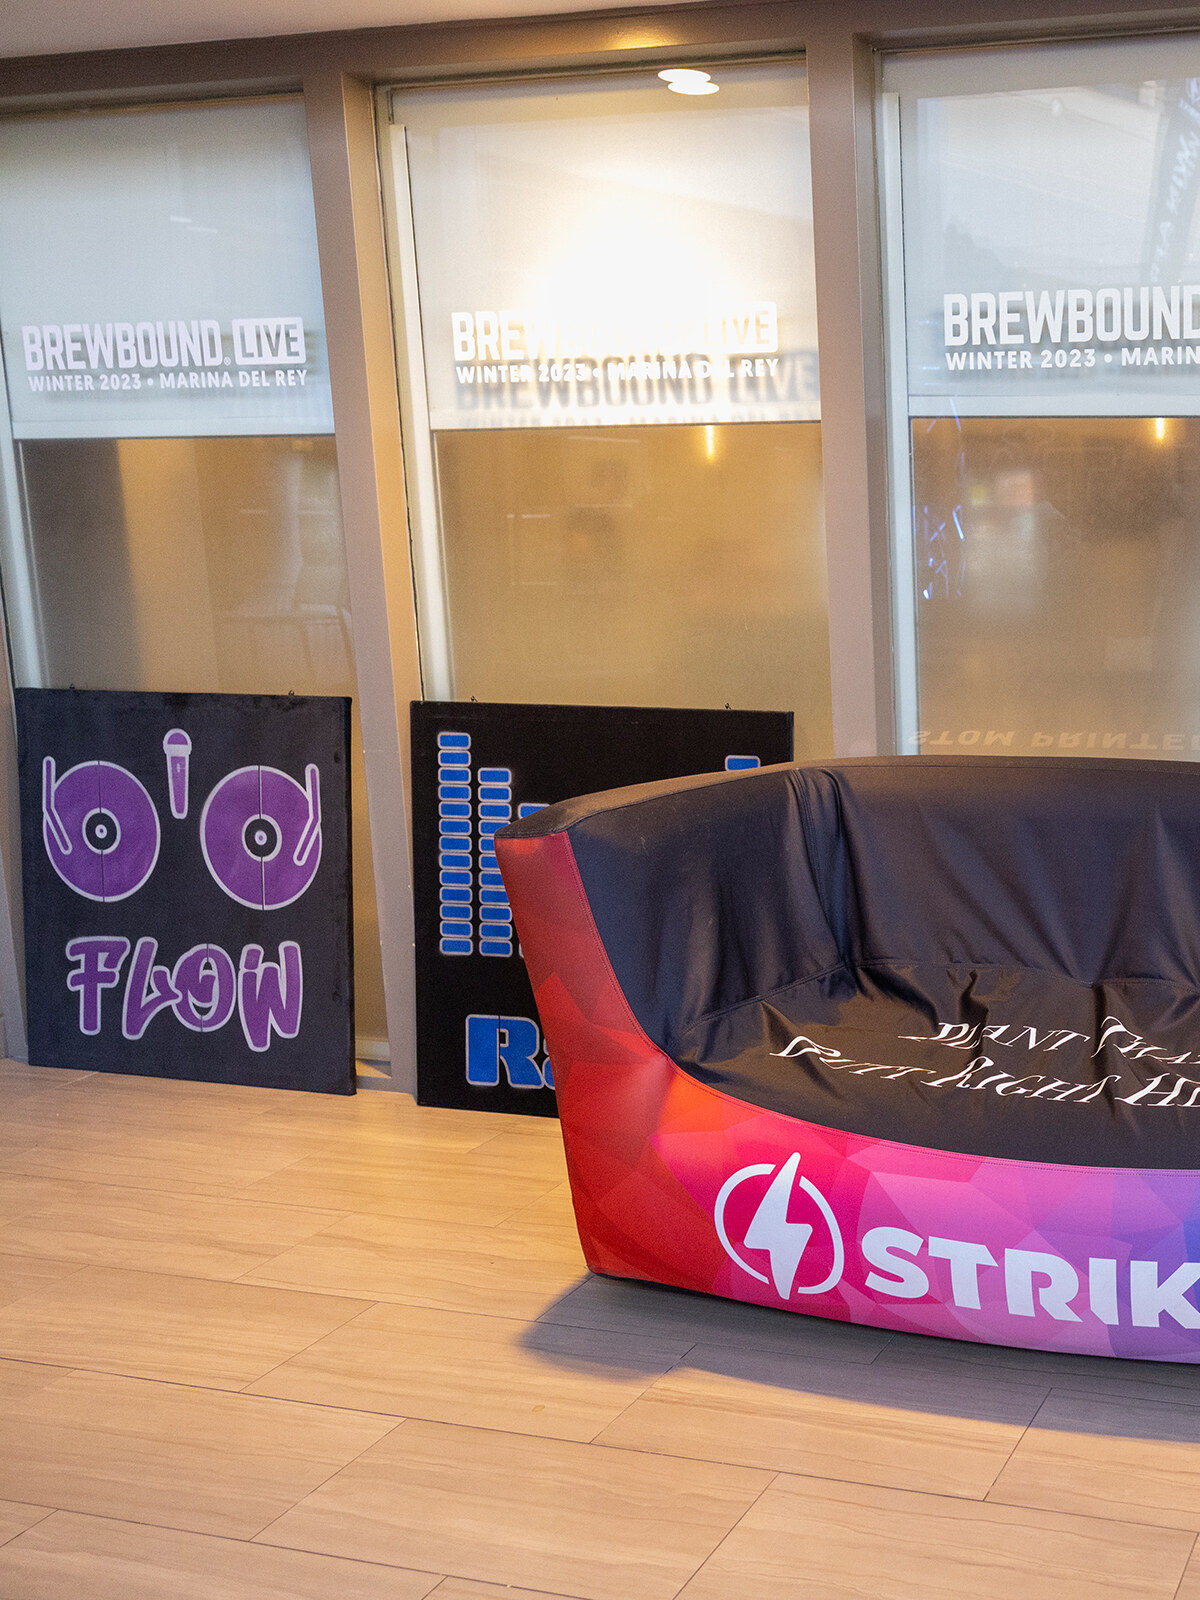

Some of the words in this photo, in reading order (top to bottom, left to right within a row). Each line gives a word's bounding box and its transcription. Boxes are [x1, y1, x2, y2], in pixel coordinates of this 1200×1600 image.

[234, 321, 303, 360] LIVE
[702, 309, 772, 346] LIVE
[456, 364, 533, 385] WINTER
[538, 362, 588, 383] 2023
[607, 360, 693, 381] MARINA
[743, 358, 779, 377] REY
[945, 350, 1033, 371] WINTER
[1040, 348, 1097, 369] 2023
[27, 373, 95, 392] WINTER
[99, 372, 142, 391] 2023
[159, 370, 234, 389] MARINA
[239, 370, 271, 388] DEL
[275, 368, 308, 386] REY
[66, 935, 303, 1053] FLOW
[466, 1014, 556, 1091] R
[897, 1021, 1092, 1052] WANT
[919, 1055, 1123, 1104] RIGHT
